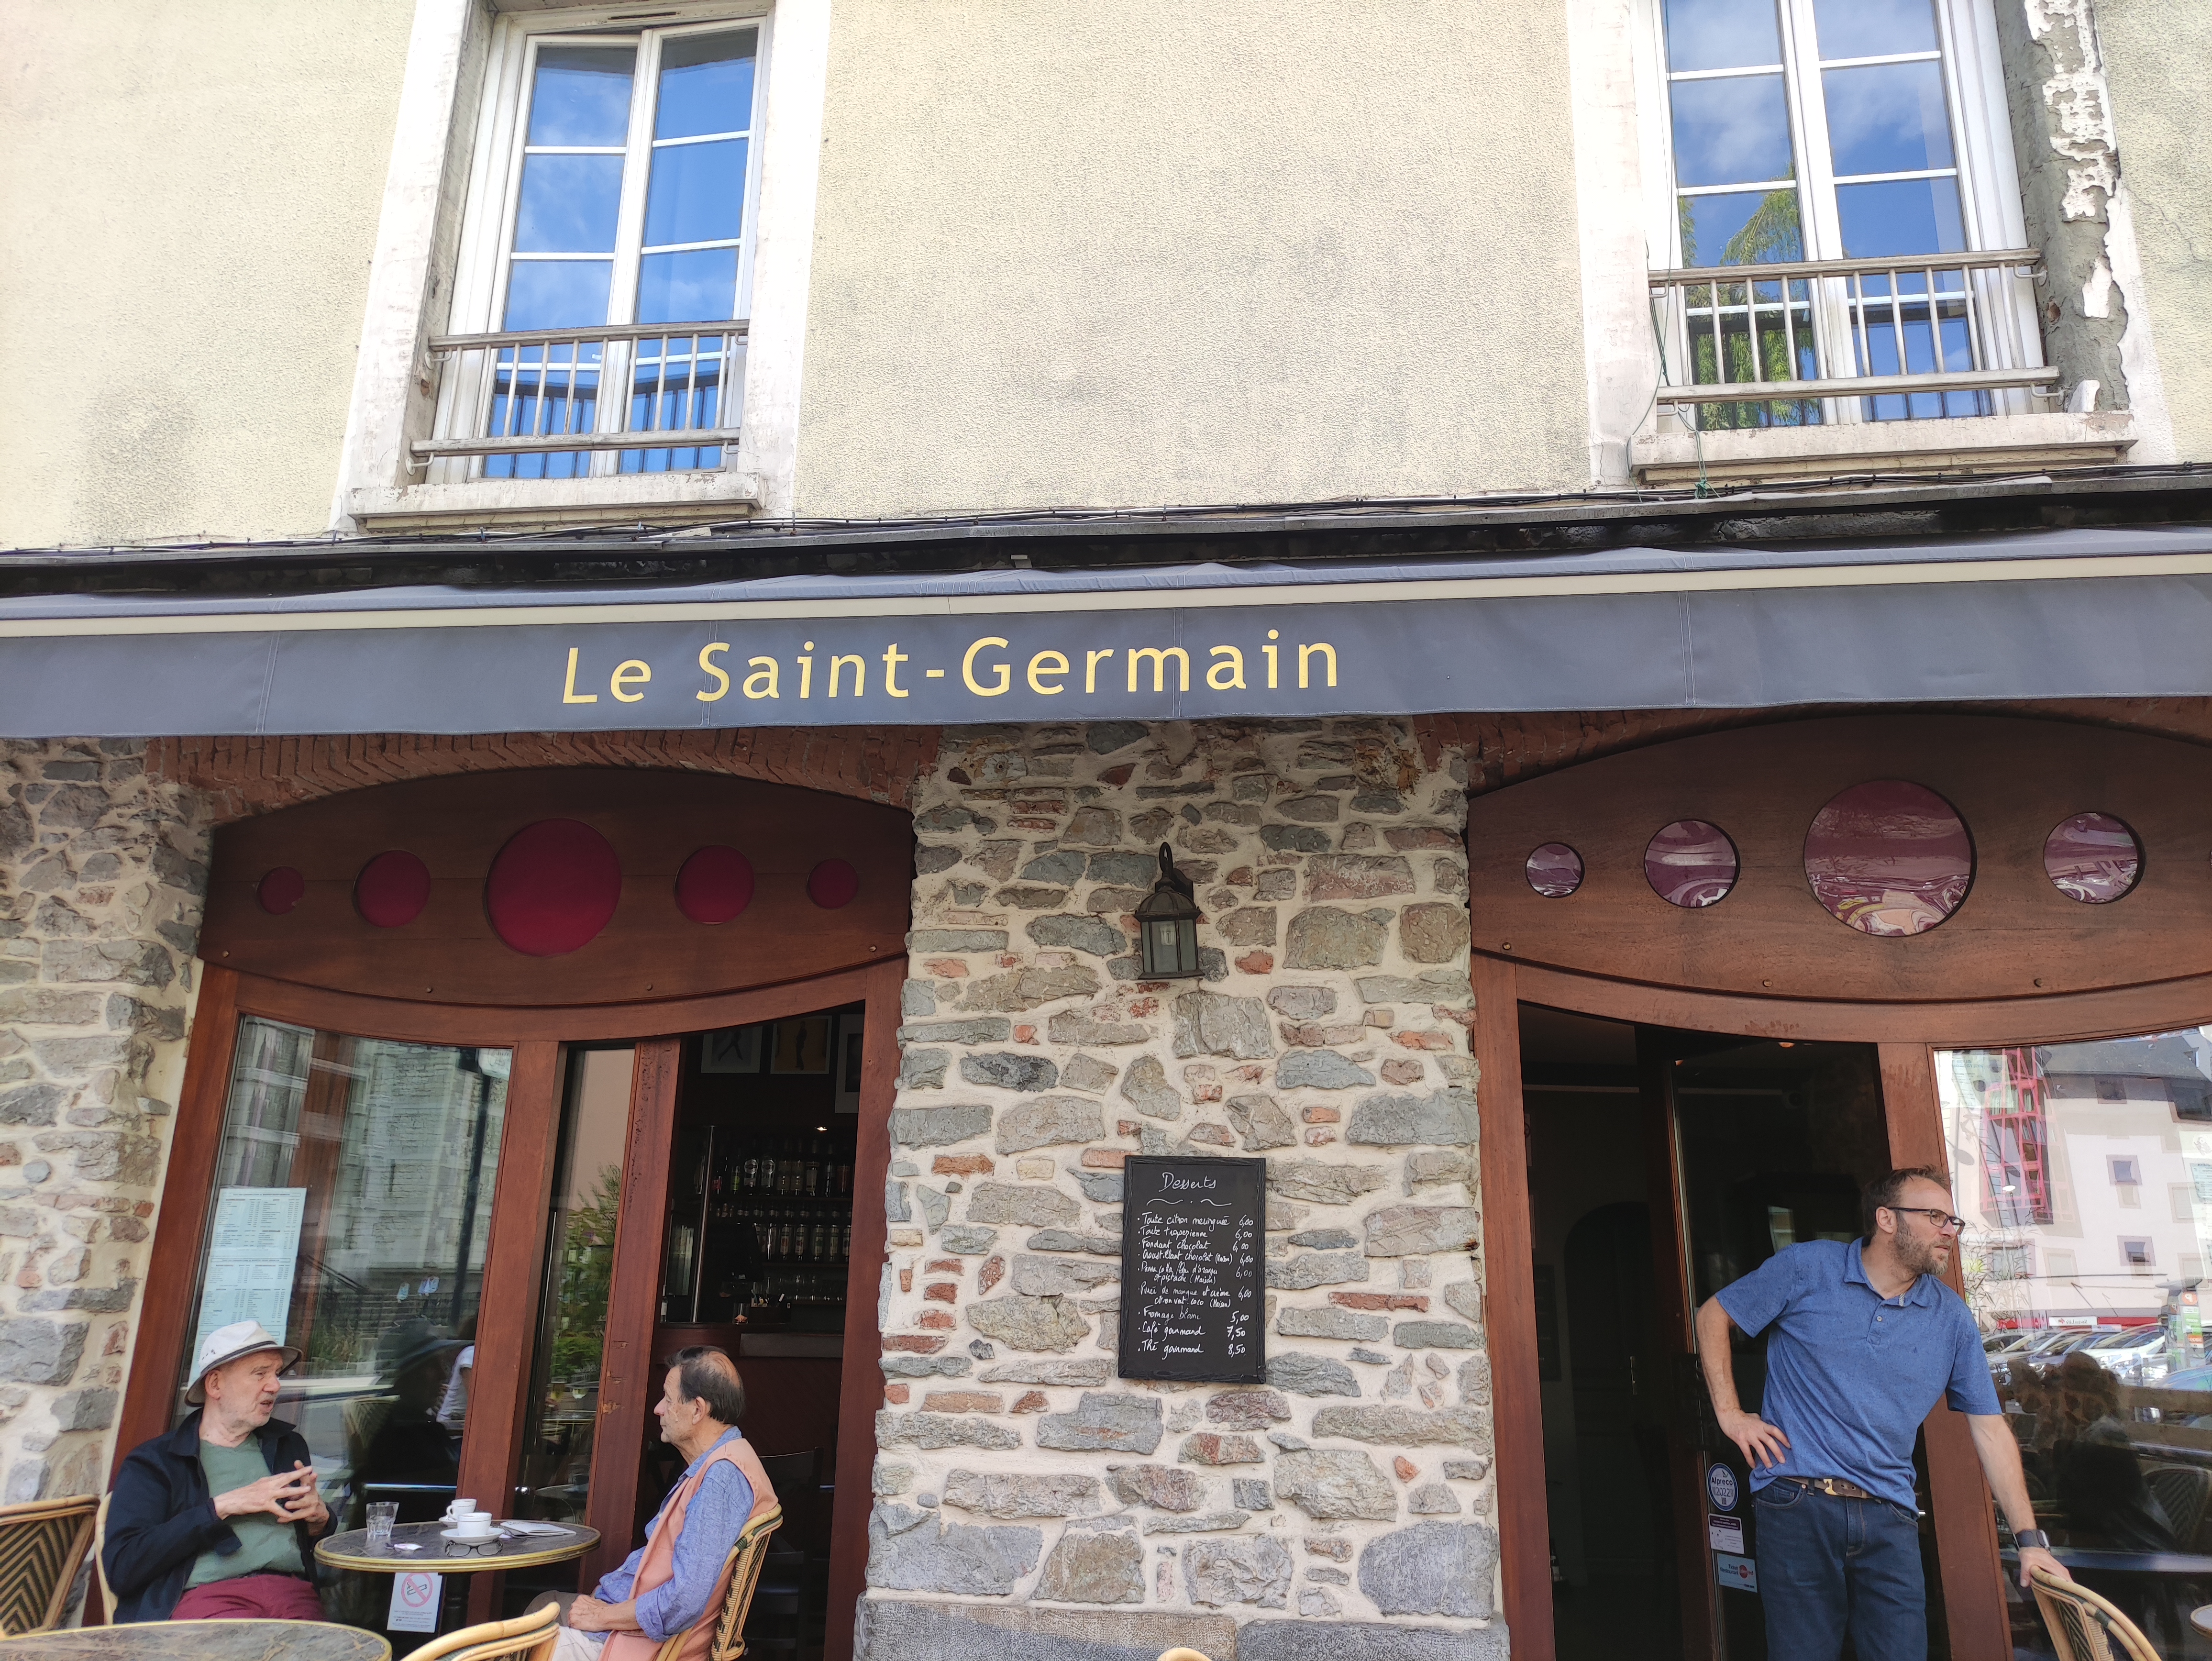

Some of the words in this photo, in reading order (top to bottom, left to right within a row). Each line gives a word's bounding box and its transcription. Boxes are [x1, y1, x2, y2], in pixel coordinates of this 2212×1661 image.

[563, 647, 652, 703] Le
[696, 629, 1338, 702] Saint-Germain
[1158, 1172, 1216, 1192] Desserts
[1166, 1213, 1188, 1224] citron
[1239, 1214, 1253, 1228] 6,00
[1235, 1229, 1252, 1241] 6,00
[1142, 1236, 1172, 1249] Fondant
[1177, 1238, 1211, 1250] chocolat
[1232, 1240, 1249, 1253] 6,00
[1184, 1250, 1214, 1262] chocolat
[1240, 1252, 1253, 1266] 6,00
[1236, 1266, 1252, 1280] 6,00
[1161, 1285, 1169, 1295] de
[1173, 1288, 1198, 1300] mangue
[1202, 1285, 1210, 1296] et
[1238, 1285, 1252, 1301] 6,00
[1143, 1305, 1174, 1325] Fromage
[1178, 1305, 1201, 1320] blanc
[1230, 1310, 1250, 1325] 5,00
[1142, 1321, 1161, 1339] Café
[1162, 1326, 1206, 1341] gourmand
[1227, 1325, 1246, 1340] 7,50
[1141, 1339, 1159, 1352] Thé
[1162, 1343, 1204, 1360] gourmand
[1228, 1343, 1246, 1358] 8,50
[1716, 1487, 1731, 1497] 2022
